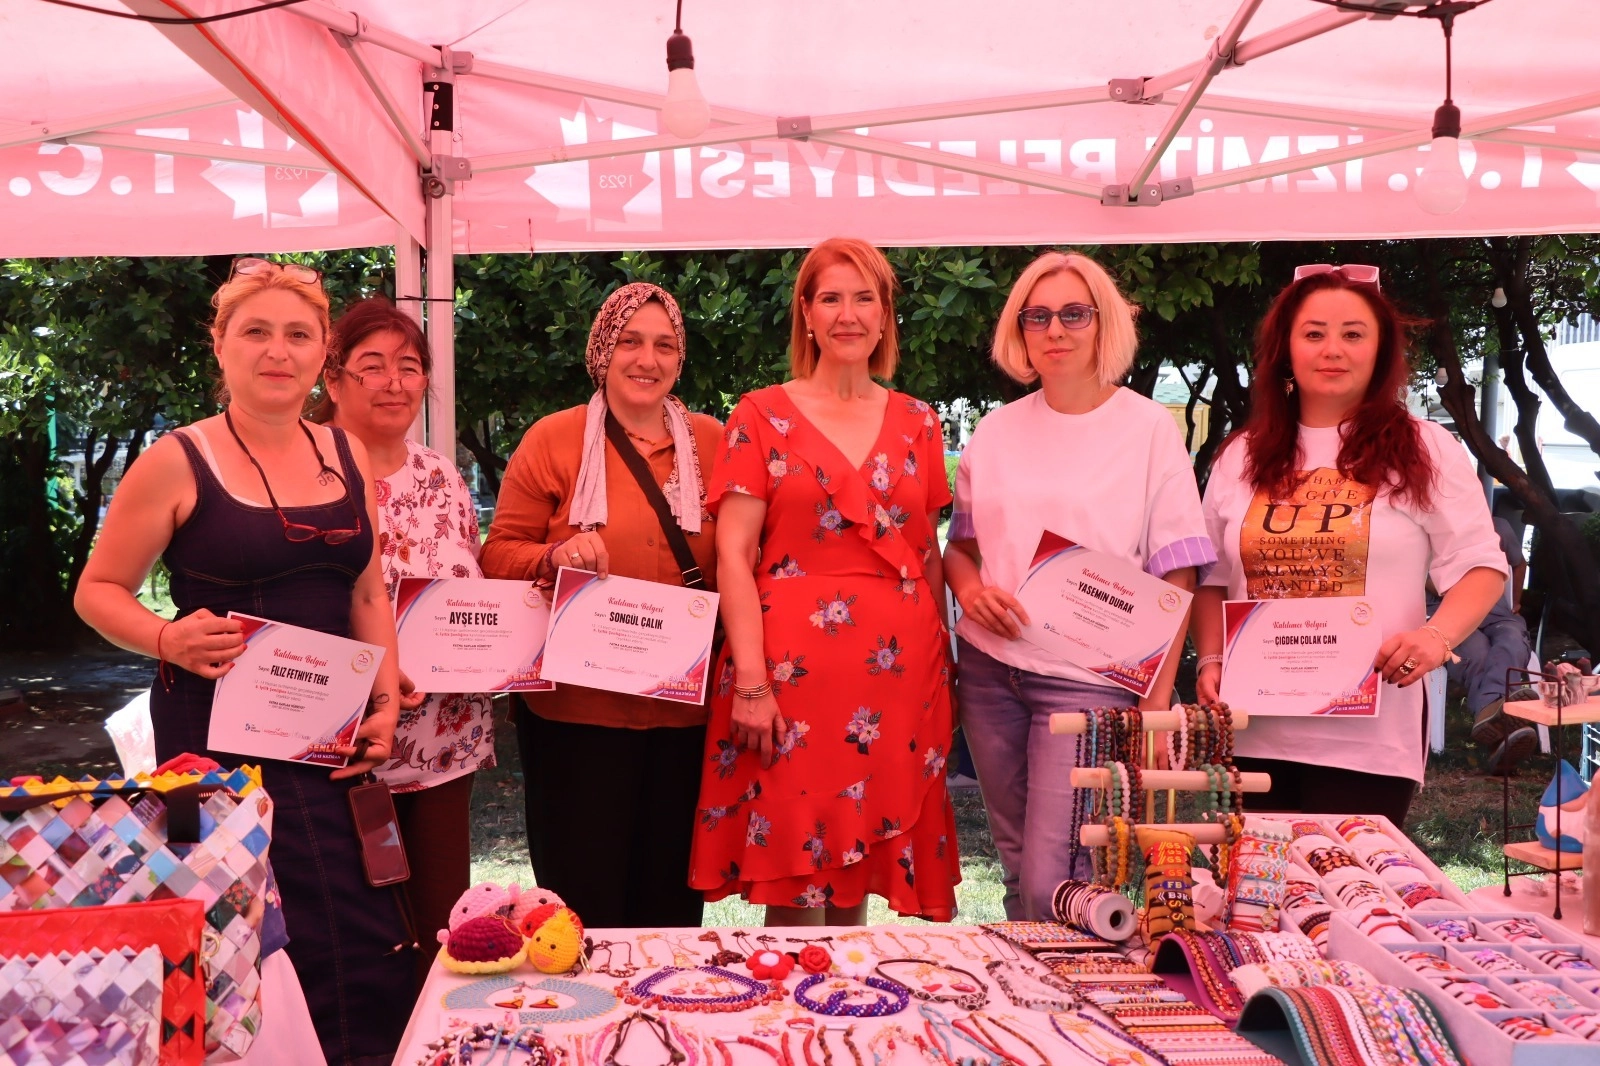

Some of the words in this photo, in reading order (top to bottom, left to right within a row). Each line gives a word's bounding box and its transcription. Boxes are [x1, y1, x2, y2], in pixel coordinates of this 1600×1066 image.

[1305, 490, 1358, 500] GIVE
[1259, 537, 1346, 545] SOMETHING
[1257, 549, 1345, 561] YOU'VE
[1261, 565, 1344, 578] ALWAYS
[1262, 579, 1343, 592] WANTED
[1109, 595, 1135, 615] DURAK
[449, 612, 473, 627] AYŞE
[475, 612, 498, 626] EYCE
[1323, 634, 1337, 645] CAN
[1167, 881, 1183, 889] FB
